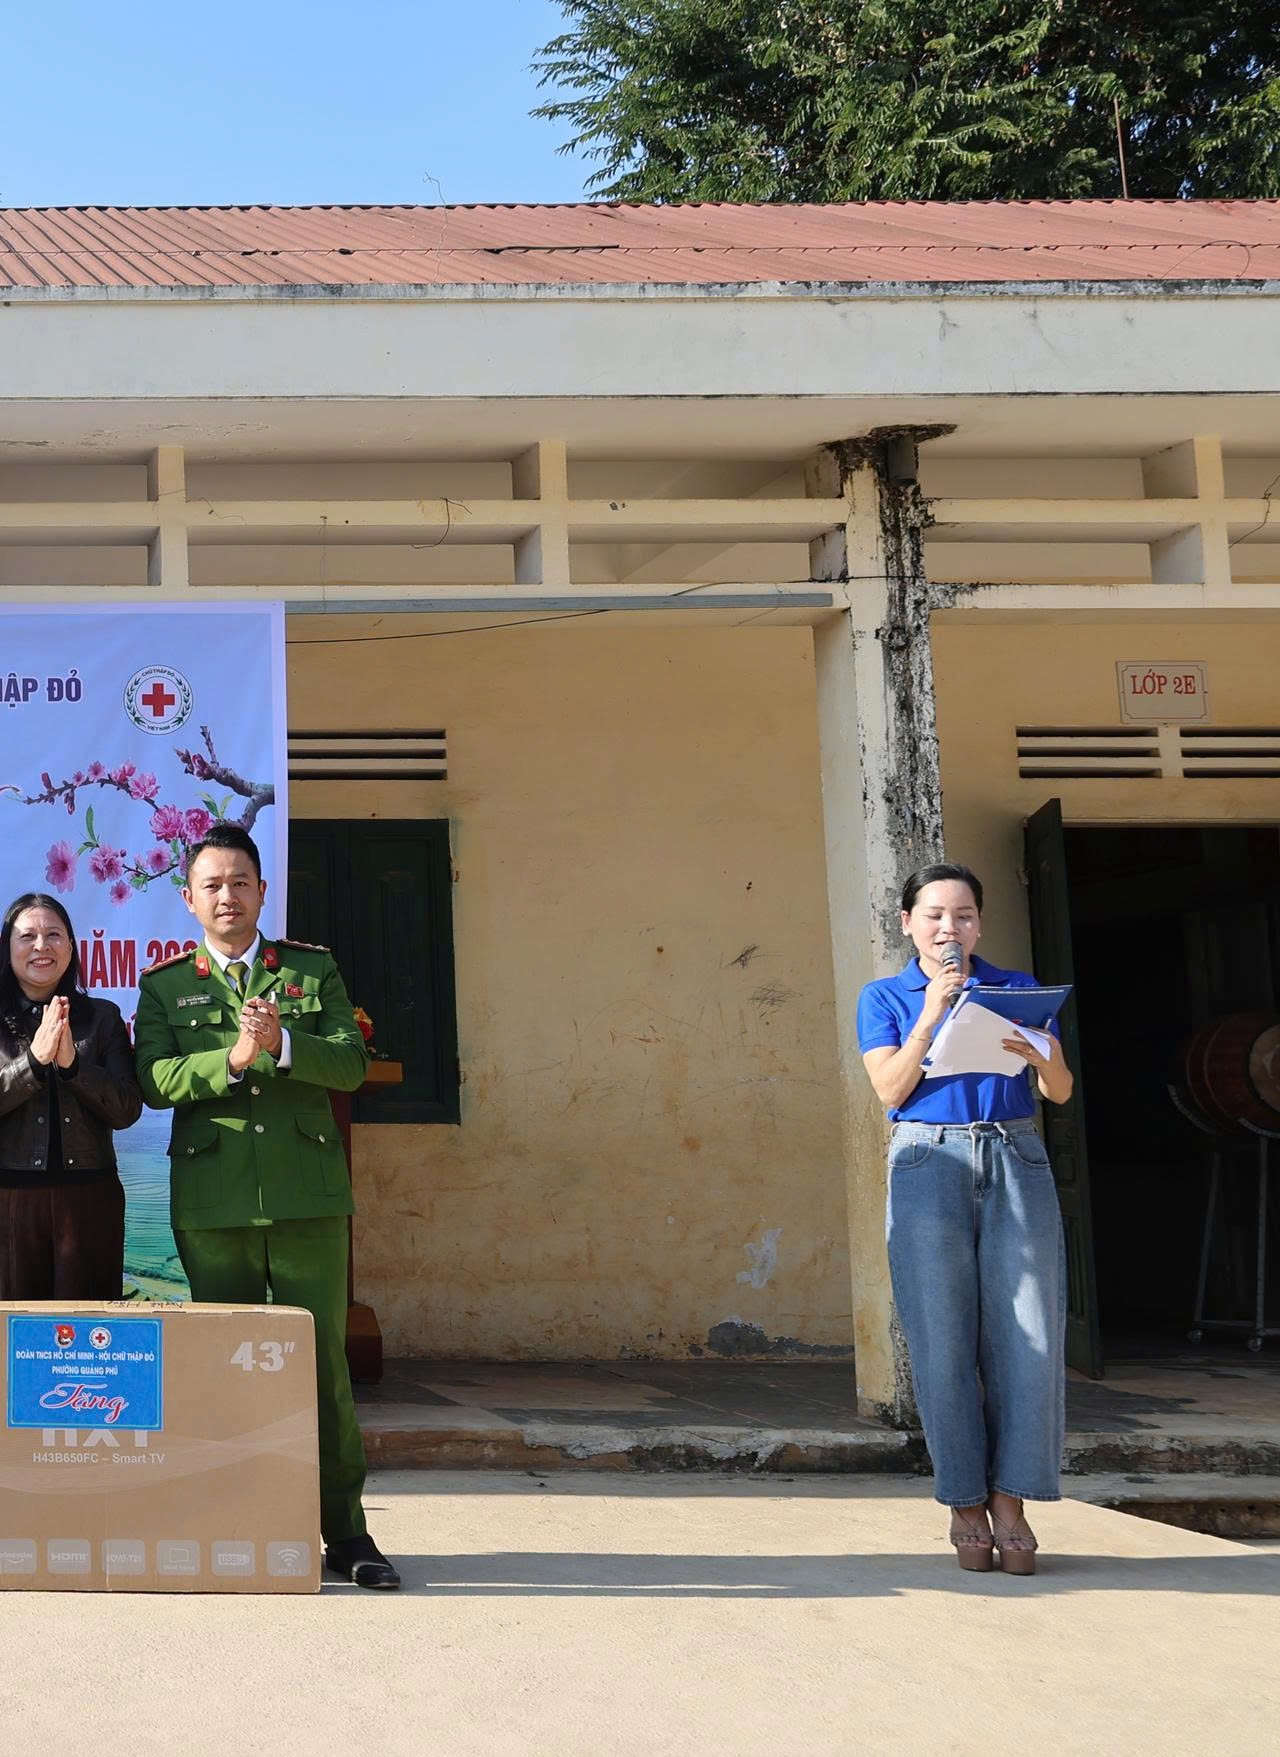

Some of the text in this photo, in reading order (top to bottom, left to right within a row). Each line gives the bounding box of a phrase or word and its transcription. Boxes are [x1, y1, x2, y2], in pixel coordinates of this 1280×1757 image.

[46, 669, 82, 702] ĐỎ
[1130, 668, 1196, 694] LỚP 2E
[16, 1349, 34, 1359] ĐOÀN
[36, 1350, 52, 1360] TNCS
[53, 1349, 63, 1360] HỒ
[64, 1349, 77, 1360] CHÍ
[77, 1352, 94, 1360] MINH
[98, 1350, 111, 1363] HỘI
[112, 1350, 126, 1361] CHỮ
[127, 1350, 143, 1363] THẬP
[144, 1350, 155, 1361] ĐỎ
[52, 1364, 118, 1375] PHƯỜNG QUẢNG PHÚ
[39, 1382, 129, 1423] Tặng
[33, 1453, 99, 1463] H43B650FC
[112, 1453, 146, 1464] Smart
[149, 1454, 166, 1464] TV
